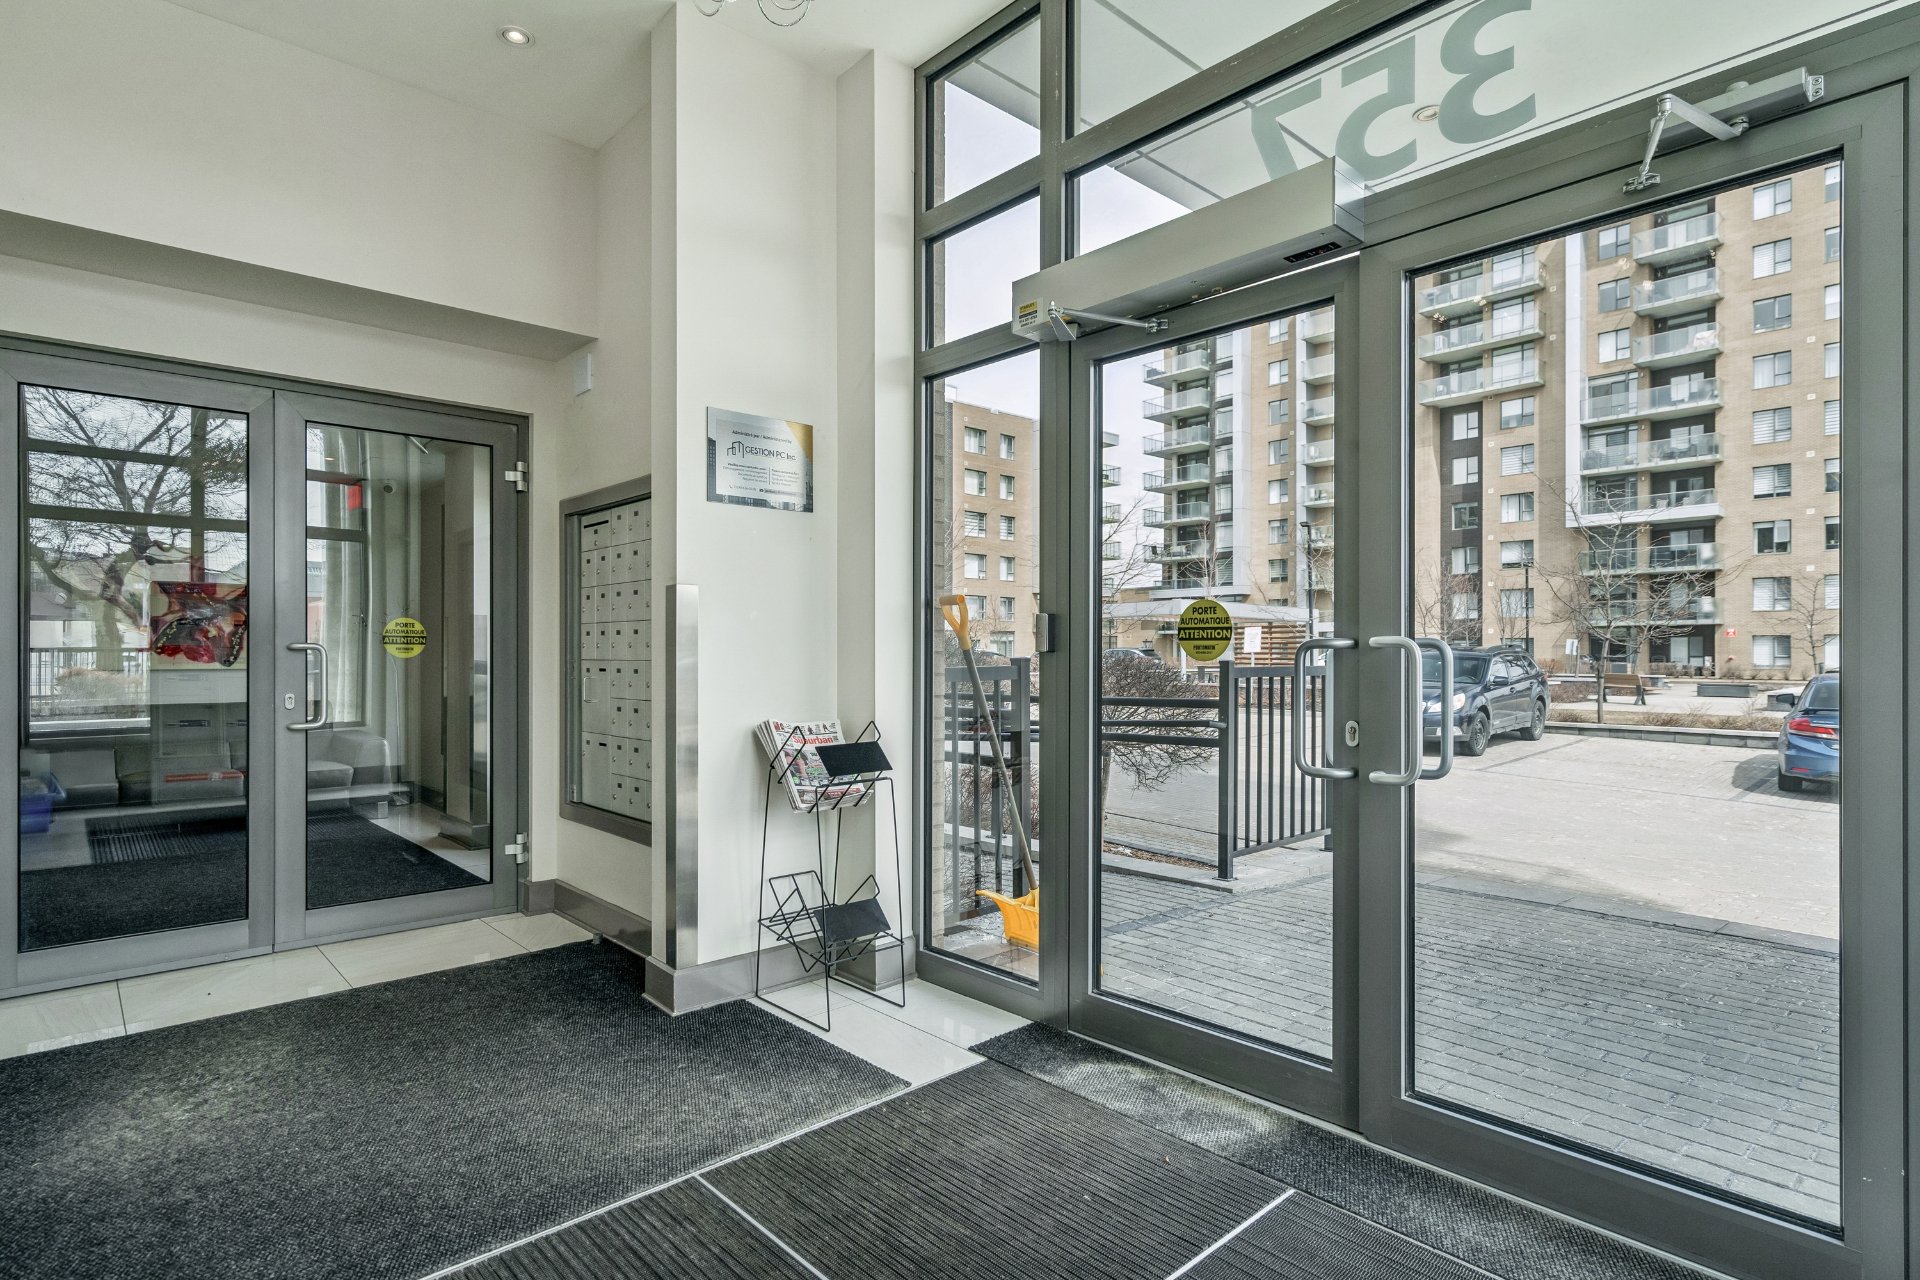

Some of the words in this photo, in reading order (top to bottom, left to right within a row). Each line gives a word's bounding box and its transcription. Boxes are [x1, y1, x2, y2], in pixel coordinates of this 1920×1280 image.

[745, 445, 775, 458] GESTION
[776, 450, 785, 459] PC
[786, 452, 796, 460] Inc.
[1192, 606, 1217, 615] PORTE
[1180, 616, 1230, 626] AUTOMATIQUE
[1179, 629, 1231, 639] ATTENTION
